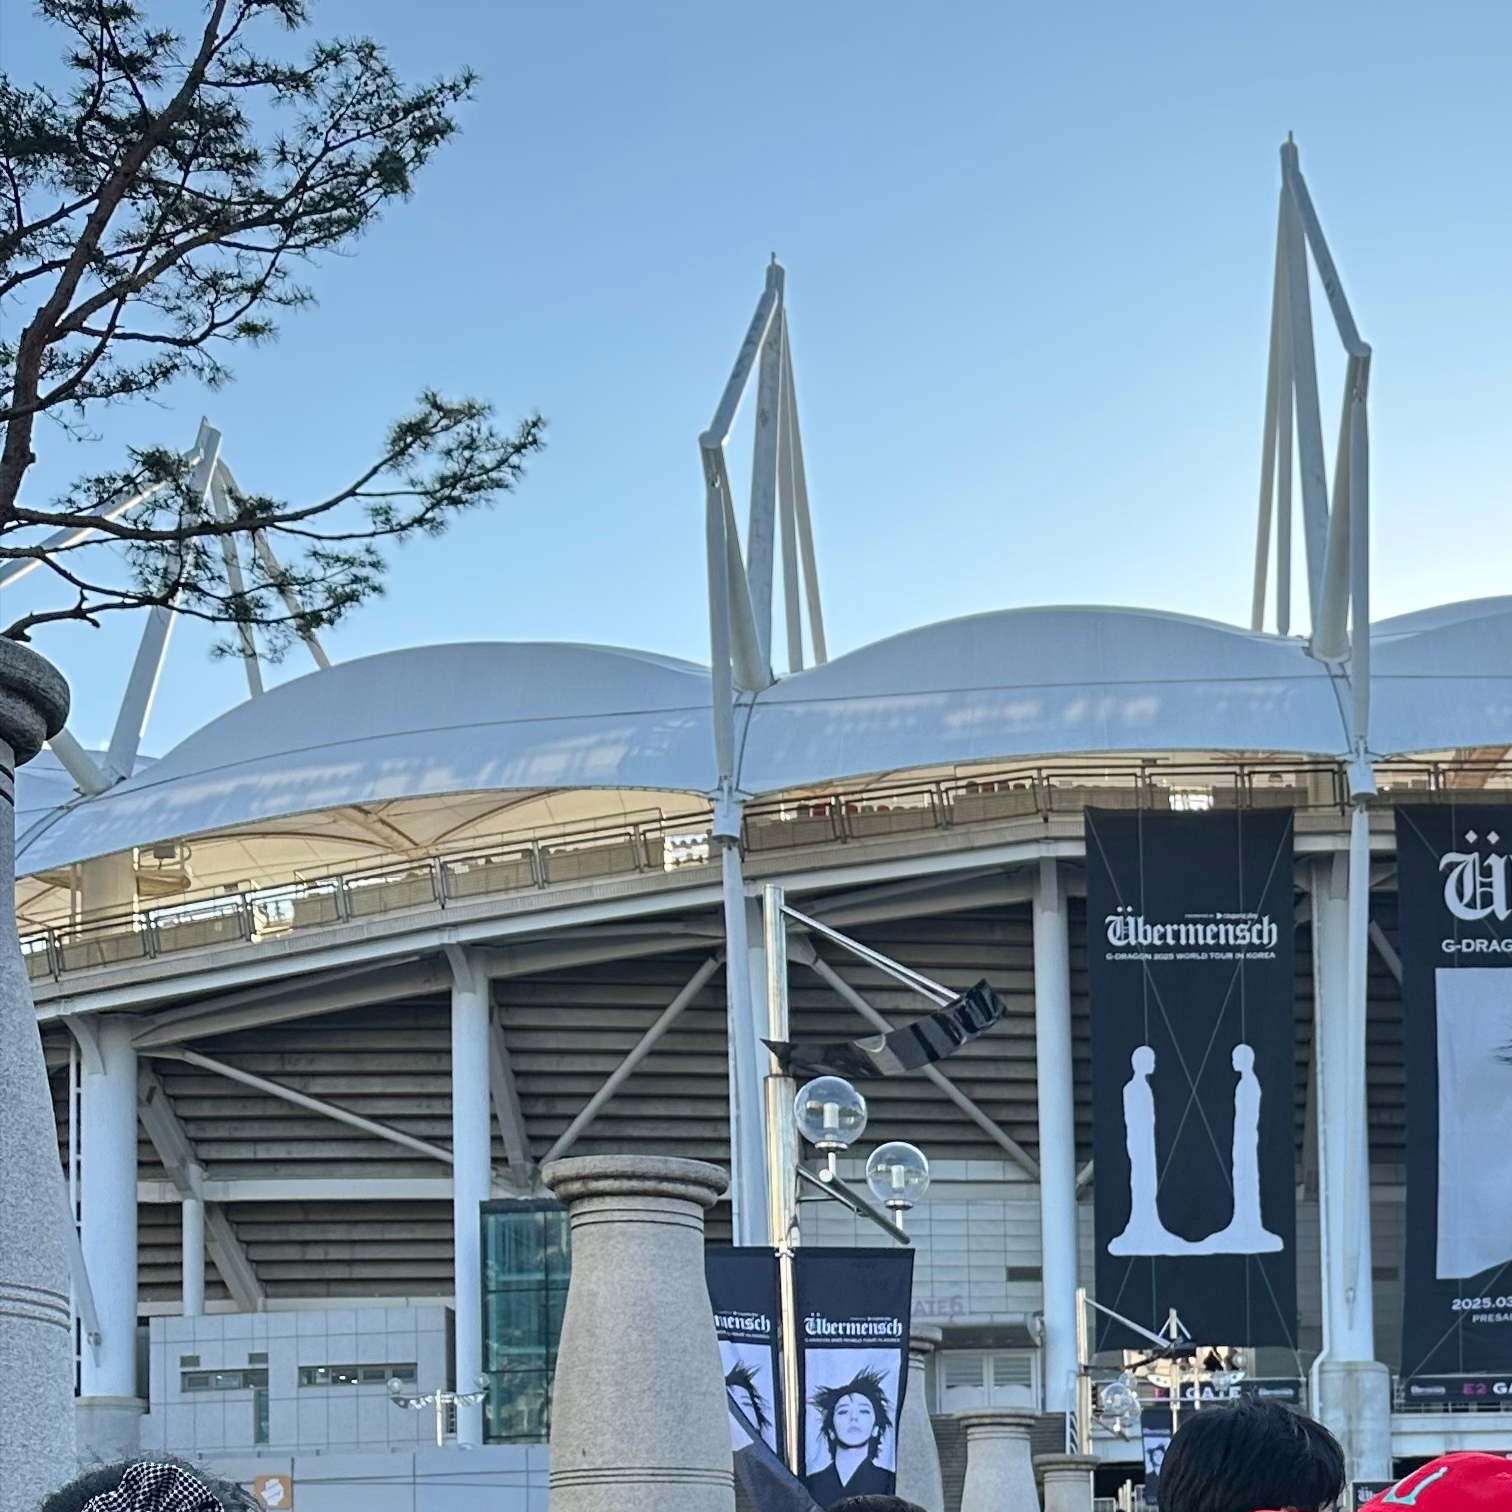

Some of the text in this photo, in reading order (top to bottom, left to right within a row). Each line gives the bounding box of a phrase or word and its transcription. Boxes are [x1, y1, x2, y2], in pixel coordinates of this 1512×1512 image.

[1105, 906, 1278, 949] Übermensch
[1209, 952, 1233, 960] TOUR
[1246, 951, 1276, 960] KOREA
[804, 1312, 902, 1336] Übermensch
[1462, 1382, 1487, 1395] E2
